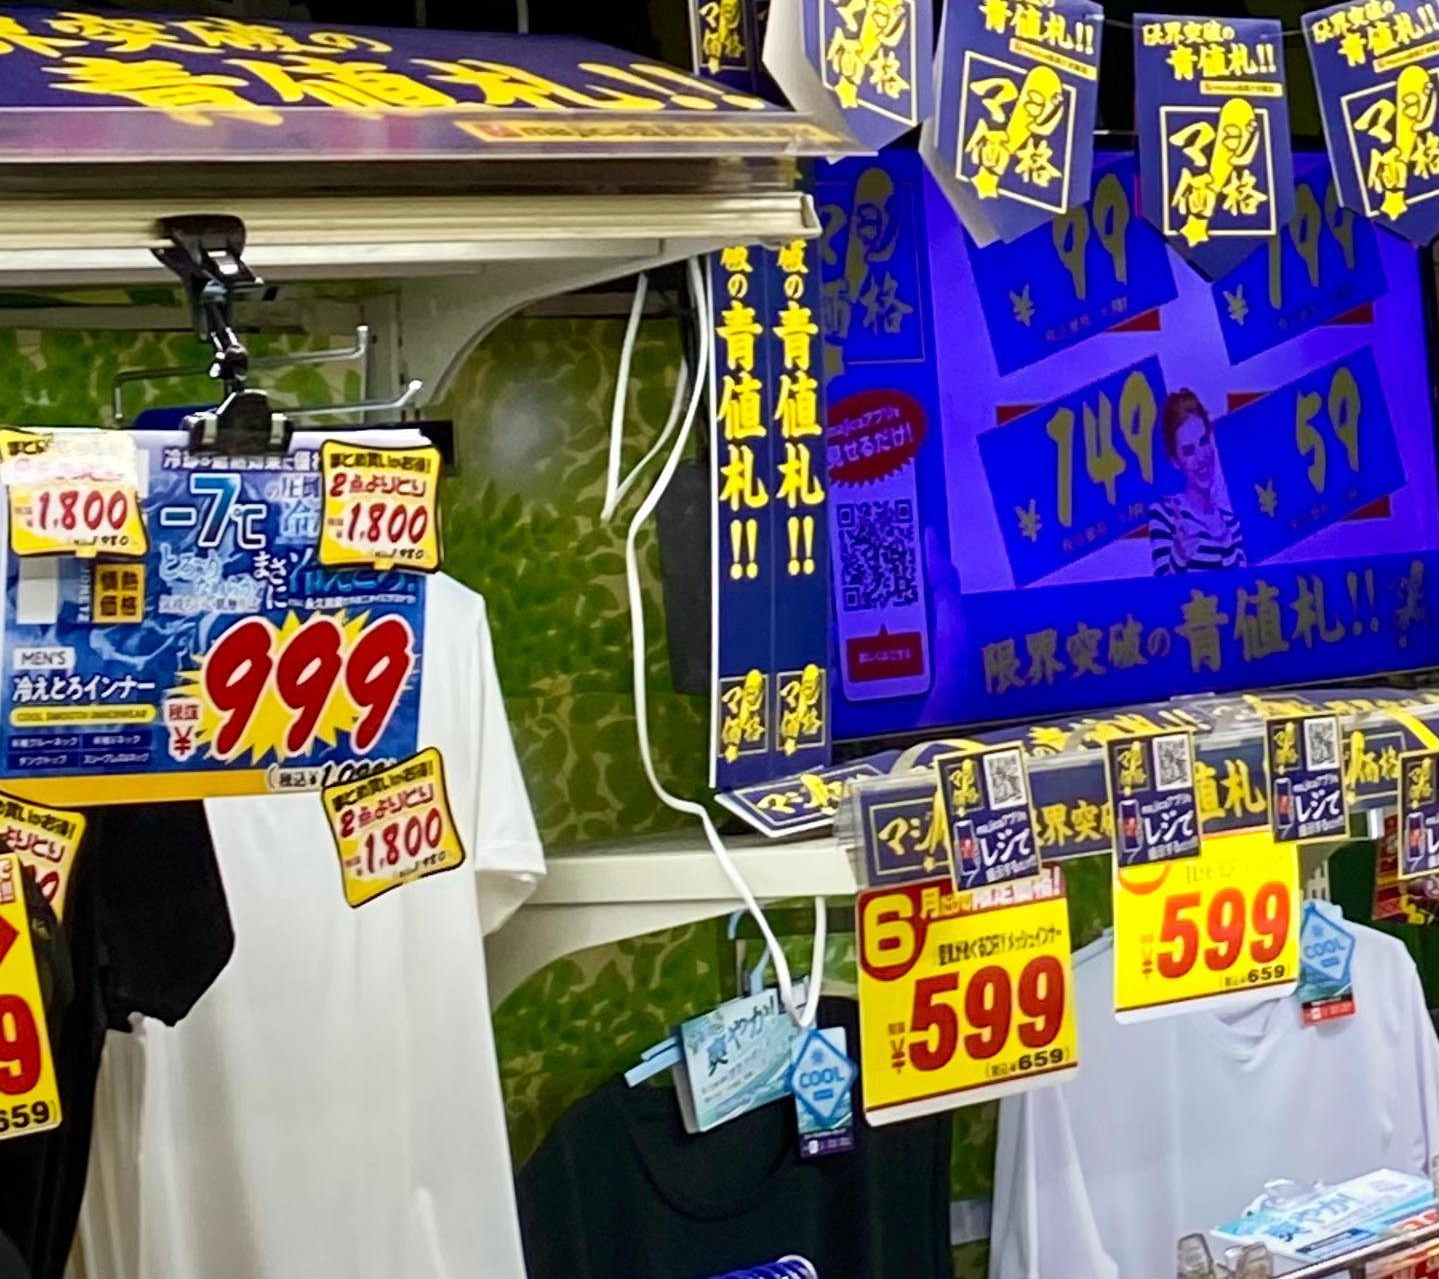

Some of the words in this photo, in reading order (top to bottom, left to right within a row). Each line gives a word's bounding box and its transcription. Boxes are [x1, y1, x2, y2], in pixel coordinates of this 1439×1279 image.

[1046, 370, 1157, 529] 149
[1295, 366, 1362, 495] 59
[347, 502, 429, 544] 1,800
[12, 674, 156, 703] 冷えとろインナー
[21, 650, 67, 665] MEN'S
[205, 618, 411, 756] 999
[983, 612, 1172, 695] 限界突破の
[365, 807, 443, 874] 1,800
[1156, 880, 1291, 979] 599
[908, 955, 1066, 1072] 599
[799, 1068, 846, 1089] COOL
